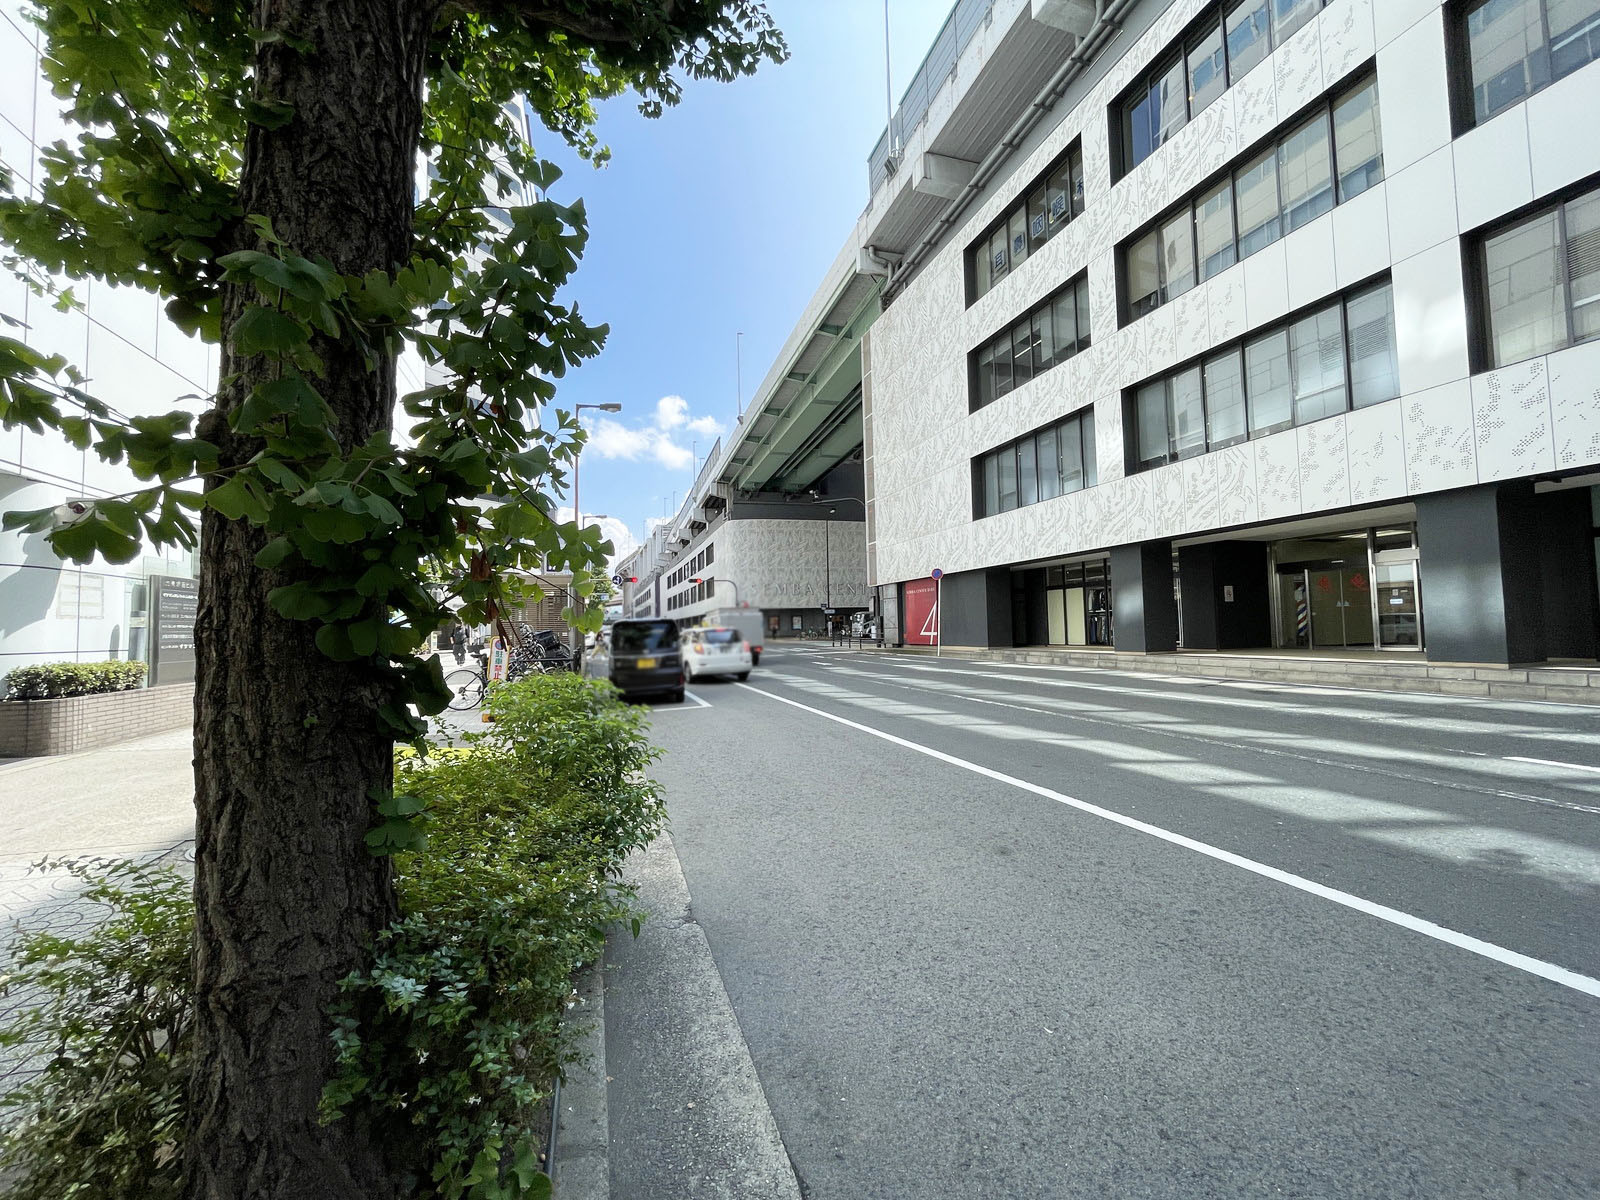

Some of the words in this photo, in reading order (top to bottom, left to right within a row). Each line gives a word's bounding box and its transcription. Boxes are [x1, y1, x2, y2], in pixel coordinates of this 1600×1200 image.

[751, 583, 815, 596] SEMBA
[920, 600, 938, 645] 4
[494, 650, 503, 680] 駐車禁止
